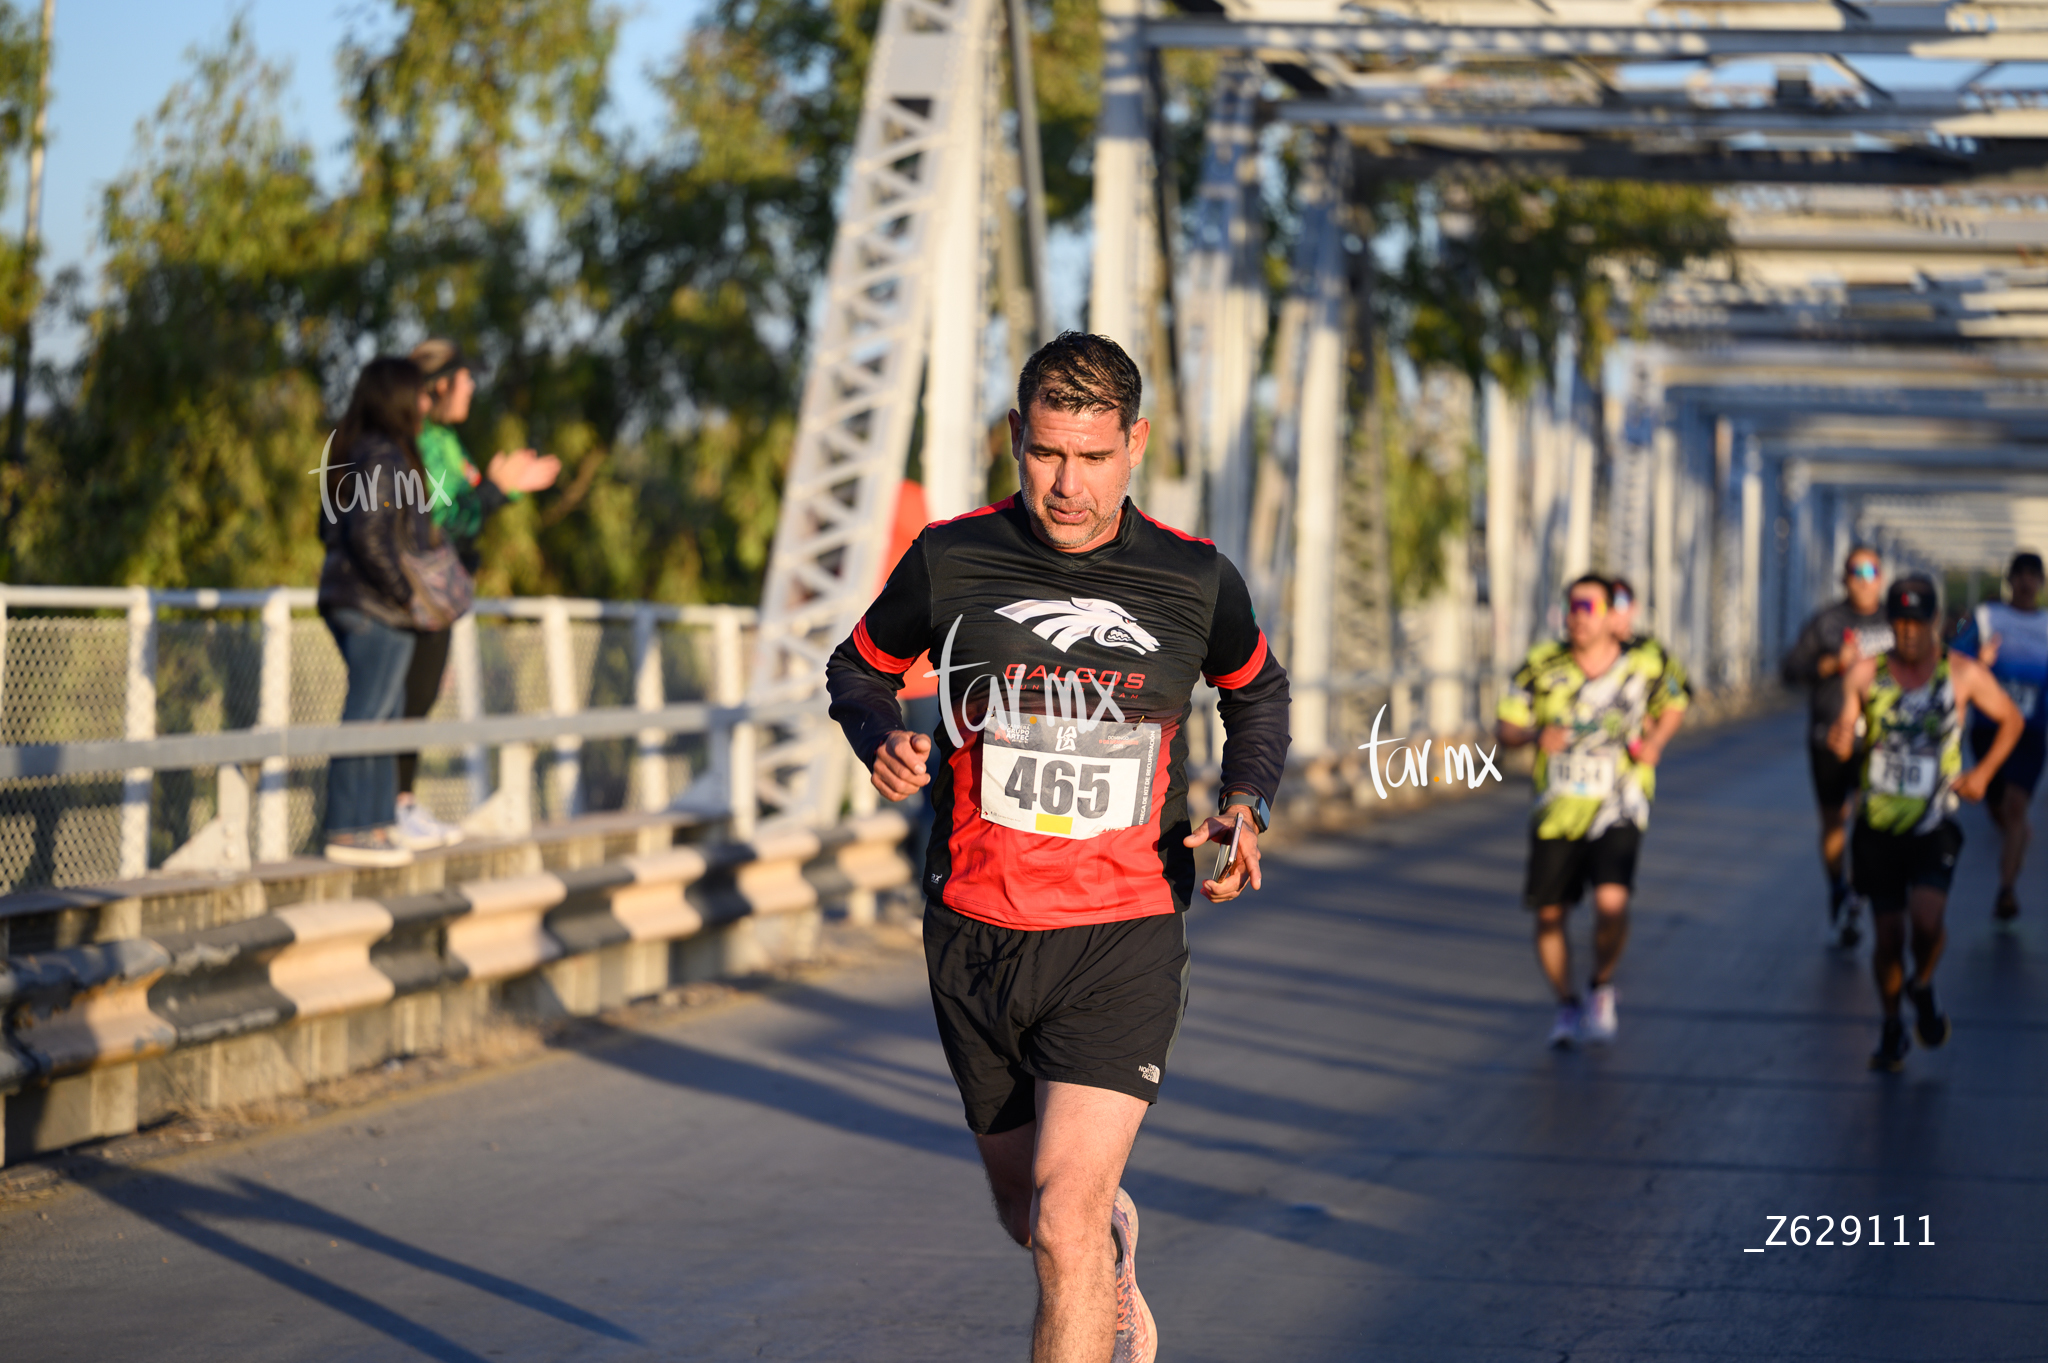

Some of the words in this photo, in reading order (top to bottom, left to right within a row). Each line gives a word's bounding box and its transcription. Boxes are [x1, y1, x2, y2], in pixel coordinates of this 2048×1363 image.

[1004, 663, 1146, 690] GALGOS
[1099, 689, 1139, 700] TEAM
[1006, 732, 1029, 742] ARTEC
[1004, 755, 1111, 819] 465
